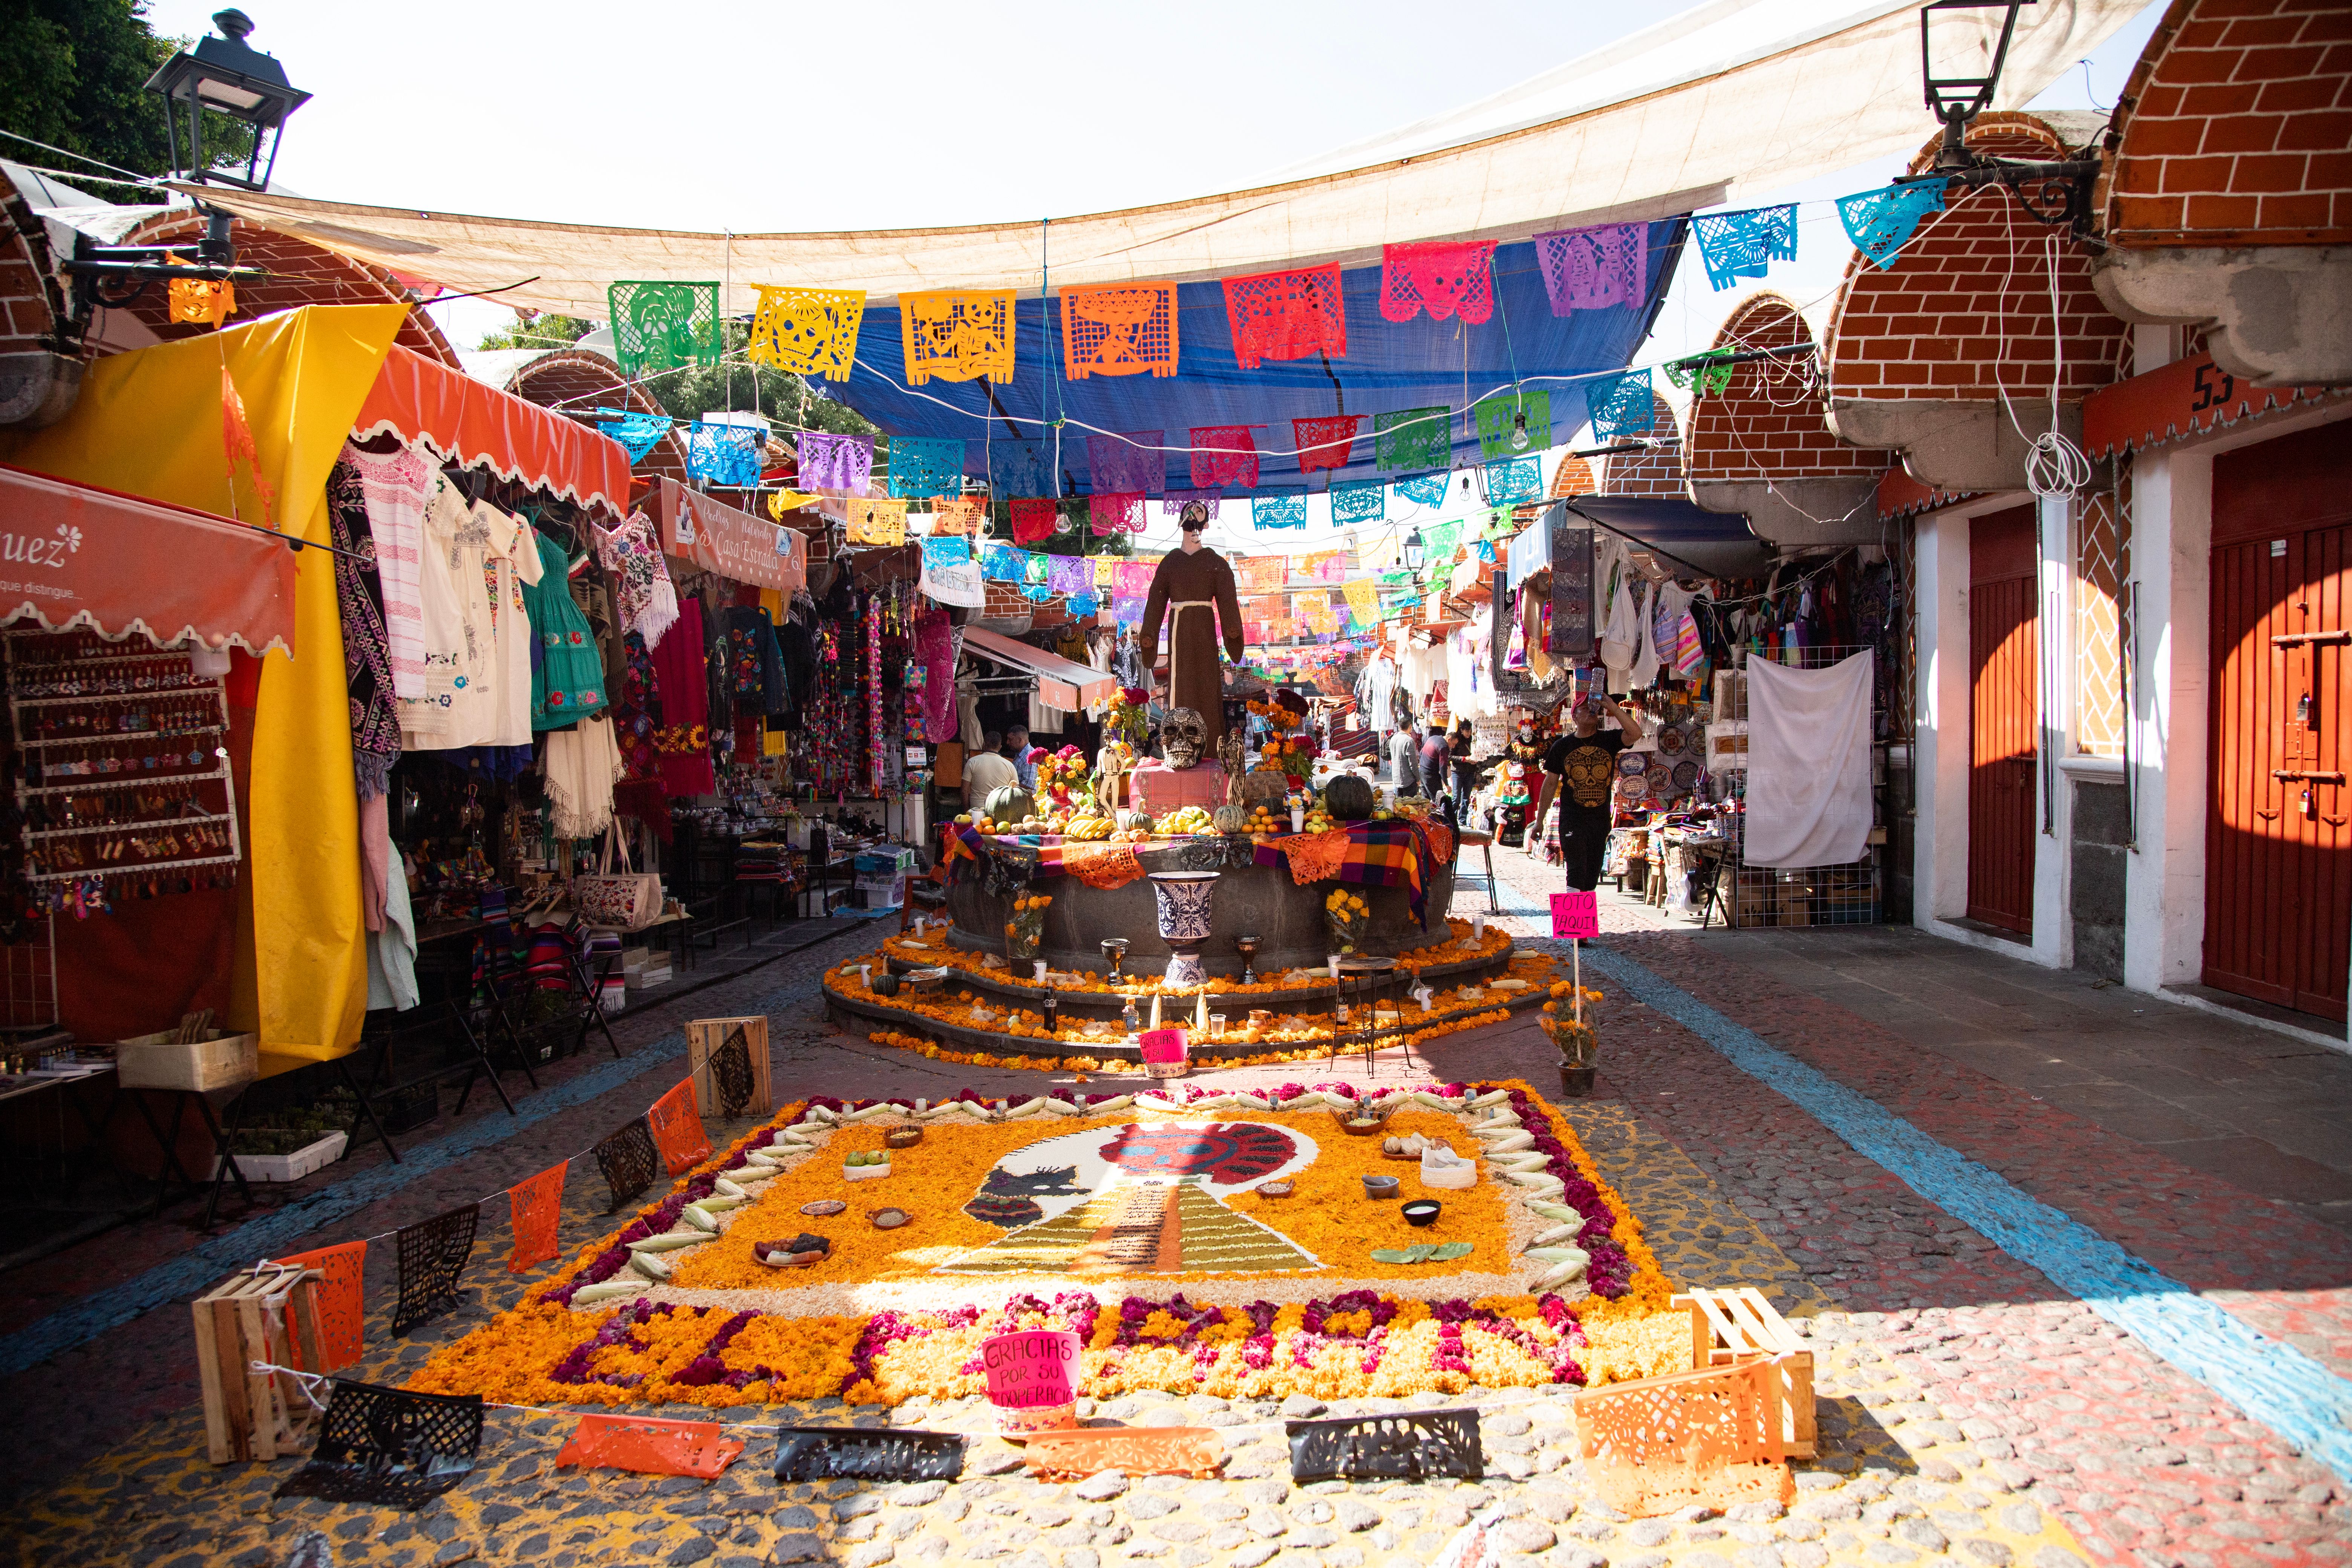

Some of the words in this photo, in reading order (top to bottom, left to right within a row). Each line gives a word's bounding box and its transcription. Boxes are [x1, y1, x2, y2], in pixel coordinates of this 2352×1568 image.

[703, 503, 729, 530] Piedras
[742, 519, 772, 545] Naturales
[0, 531, 65, 567] uez
[699, 528, 711, 547] 63
[717, 531, 739, 558] Casa
[741, 541, 779, 570] Estrada
[947, 570, 973, 592] ESTRADA
[1553, 894, 1594, 910] FOTO
[1141, 1034, 1175, 1049] GRACIAS
[1153, 1048, 1163, 1057] SU
[985, 1338, 1072, 1369] GRACIAS
[1000, 1365, 1029, 1387] POR
[1039, 1364, 1059, 1379] SU
